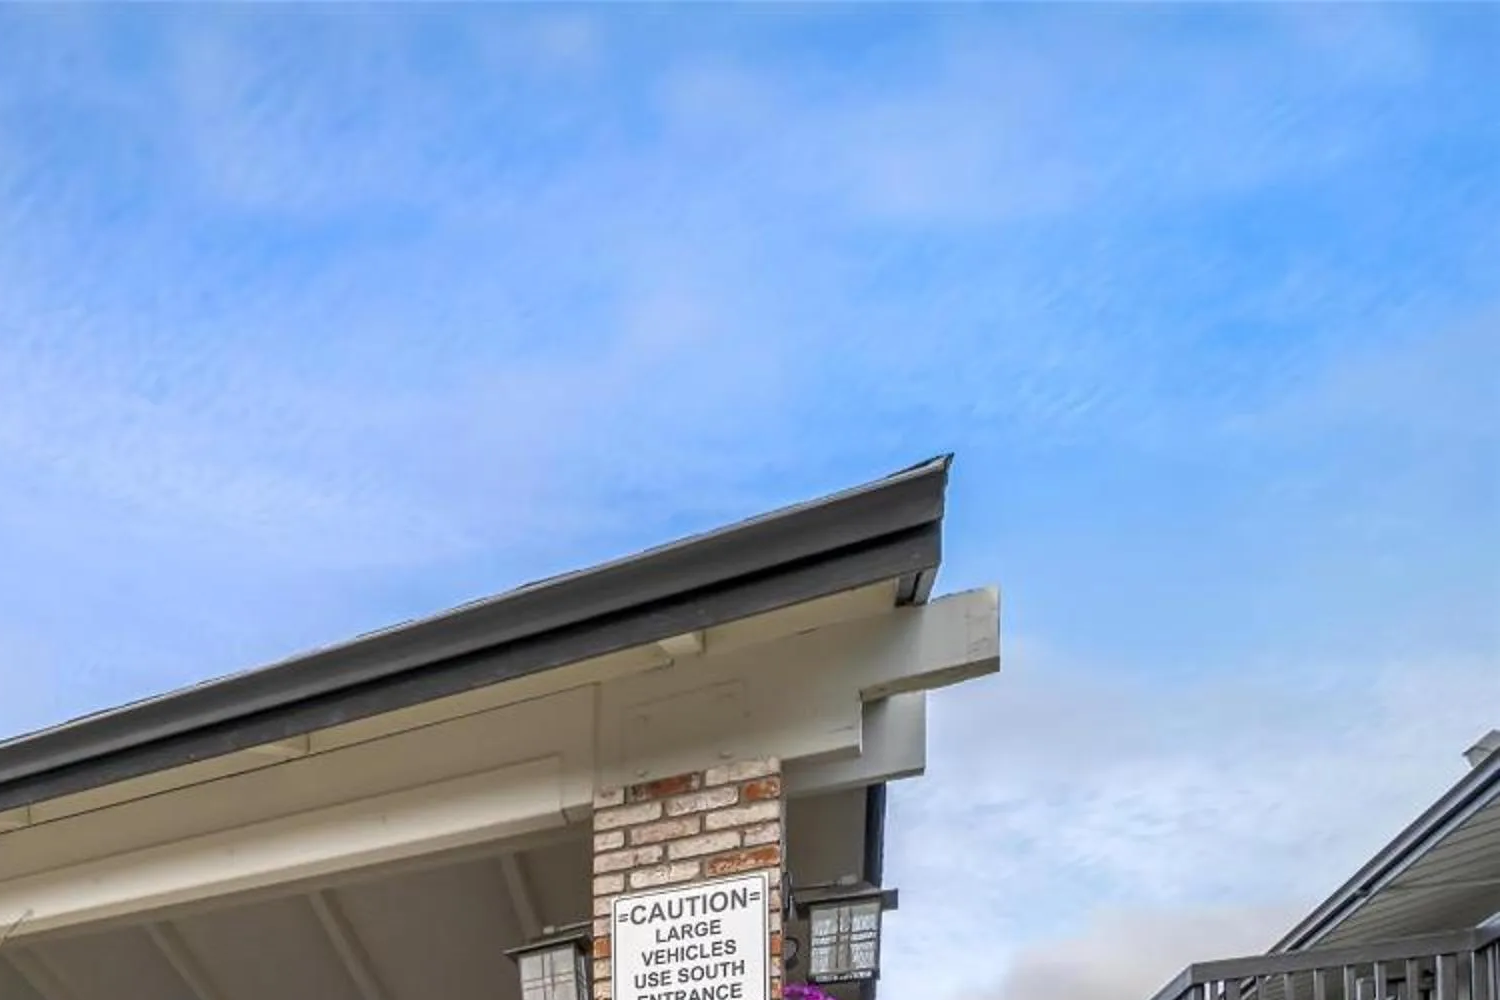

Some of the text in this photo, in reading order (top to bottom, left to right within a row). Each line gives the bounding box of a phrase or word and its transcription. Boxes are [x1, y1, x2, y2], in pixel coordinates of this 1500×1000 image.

[656, 919, 722, 943] LARGE
[641, 939, 737, 966] VEHICLES
[634, 960, 745, 989] USE SOUTH
